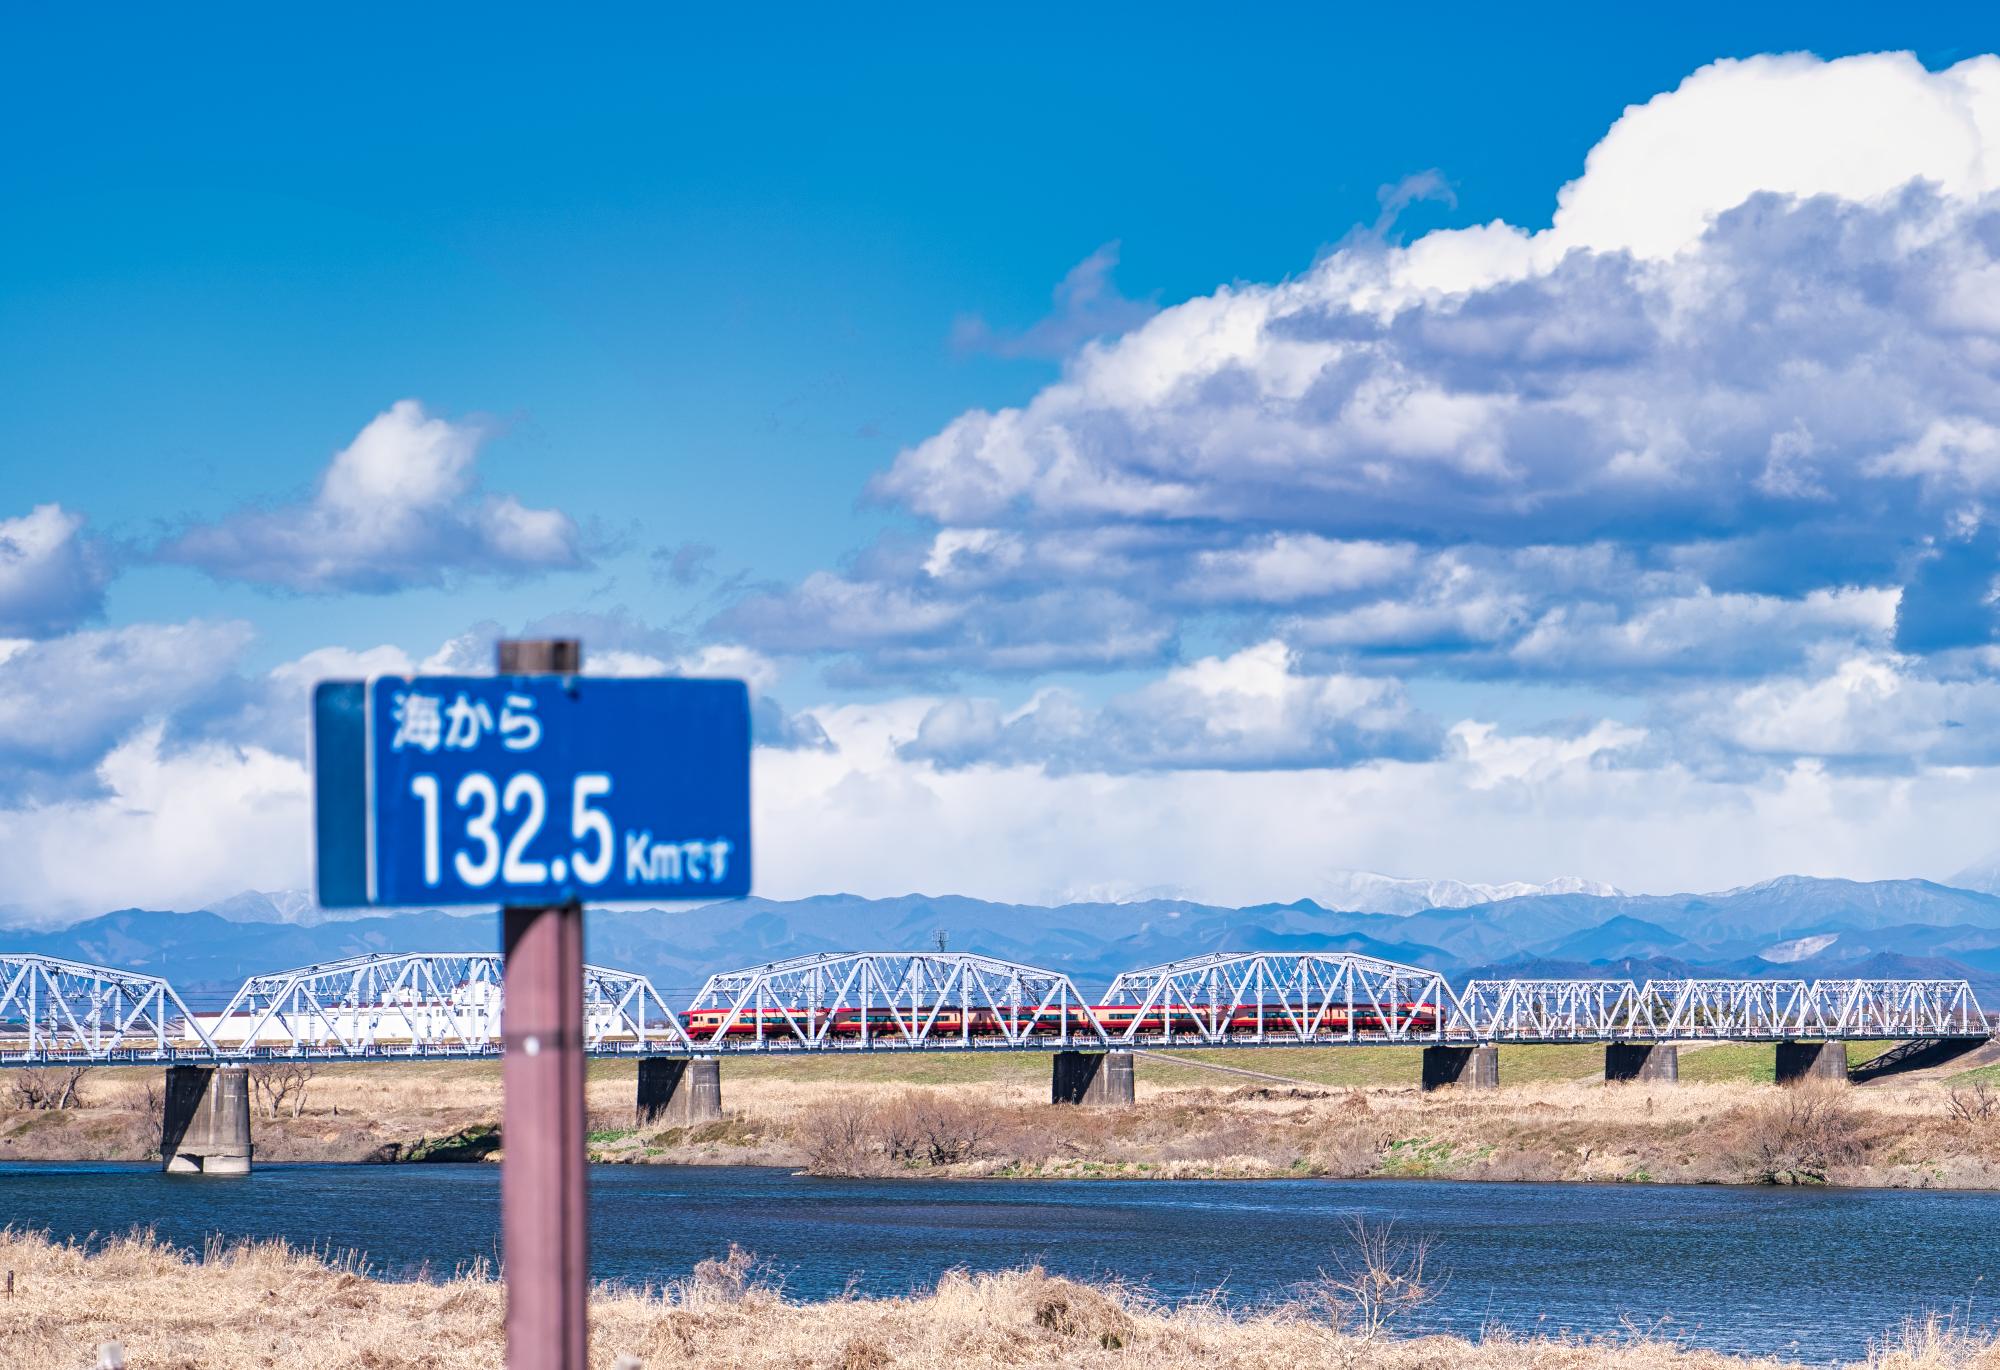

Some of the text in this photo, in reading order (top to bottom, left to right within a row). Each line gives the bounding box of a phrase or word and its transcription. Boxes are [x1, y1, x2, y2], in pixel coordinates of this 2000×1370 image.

[392, 693, 541, 750] 海から
[411, 773, 614, 886] 132.5
